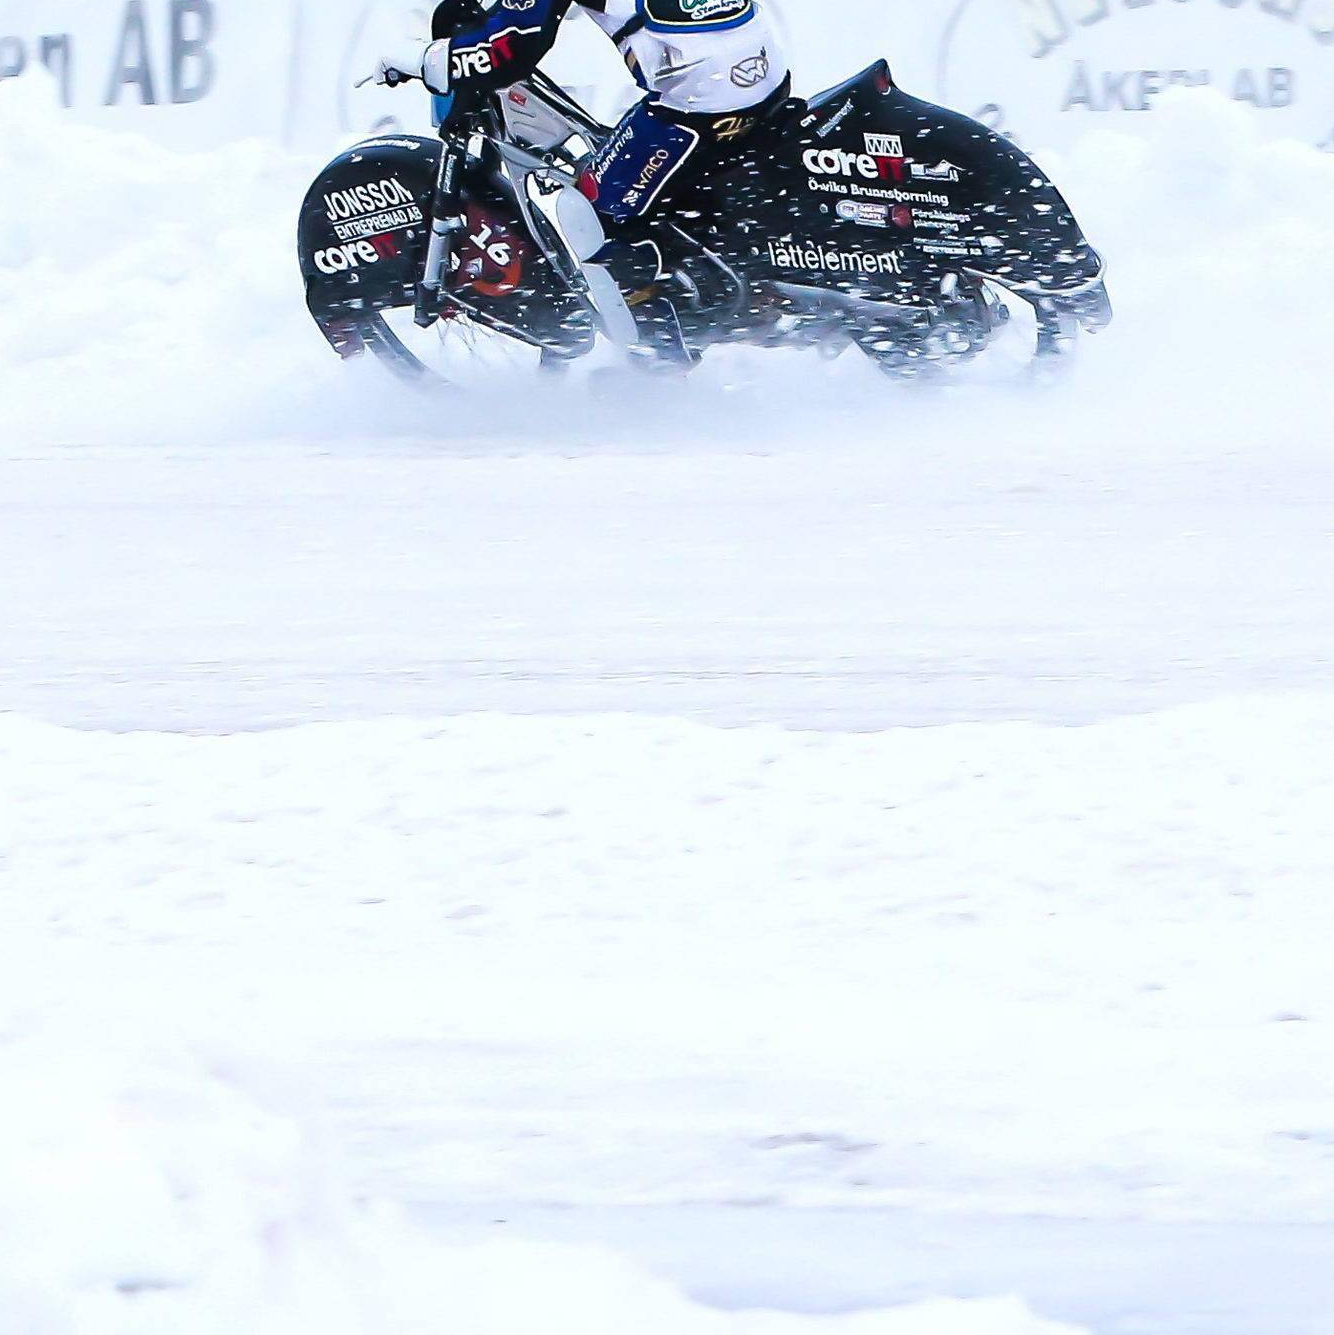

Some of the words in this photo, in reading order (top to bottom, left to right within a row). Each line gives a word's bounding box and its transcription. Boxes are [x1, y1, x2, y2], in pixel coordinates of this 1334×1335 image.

[1061, 60, 1210, 112] ÅKE
[1230, 66, 1294, 108] AB
[323, 177, 413, 221] JONSSON
[333, 210, 407, 240] ENTREPRENAD
